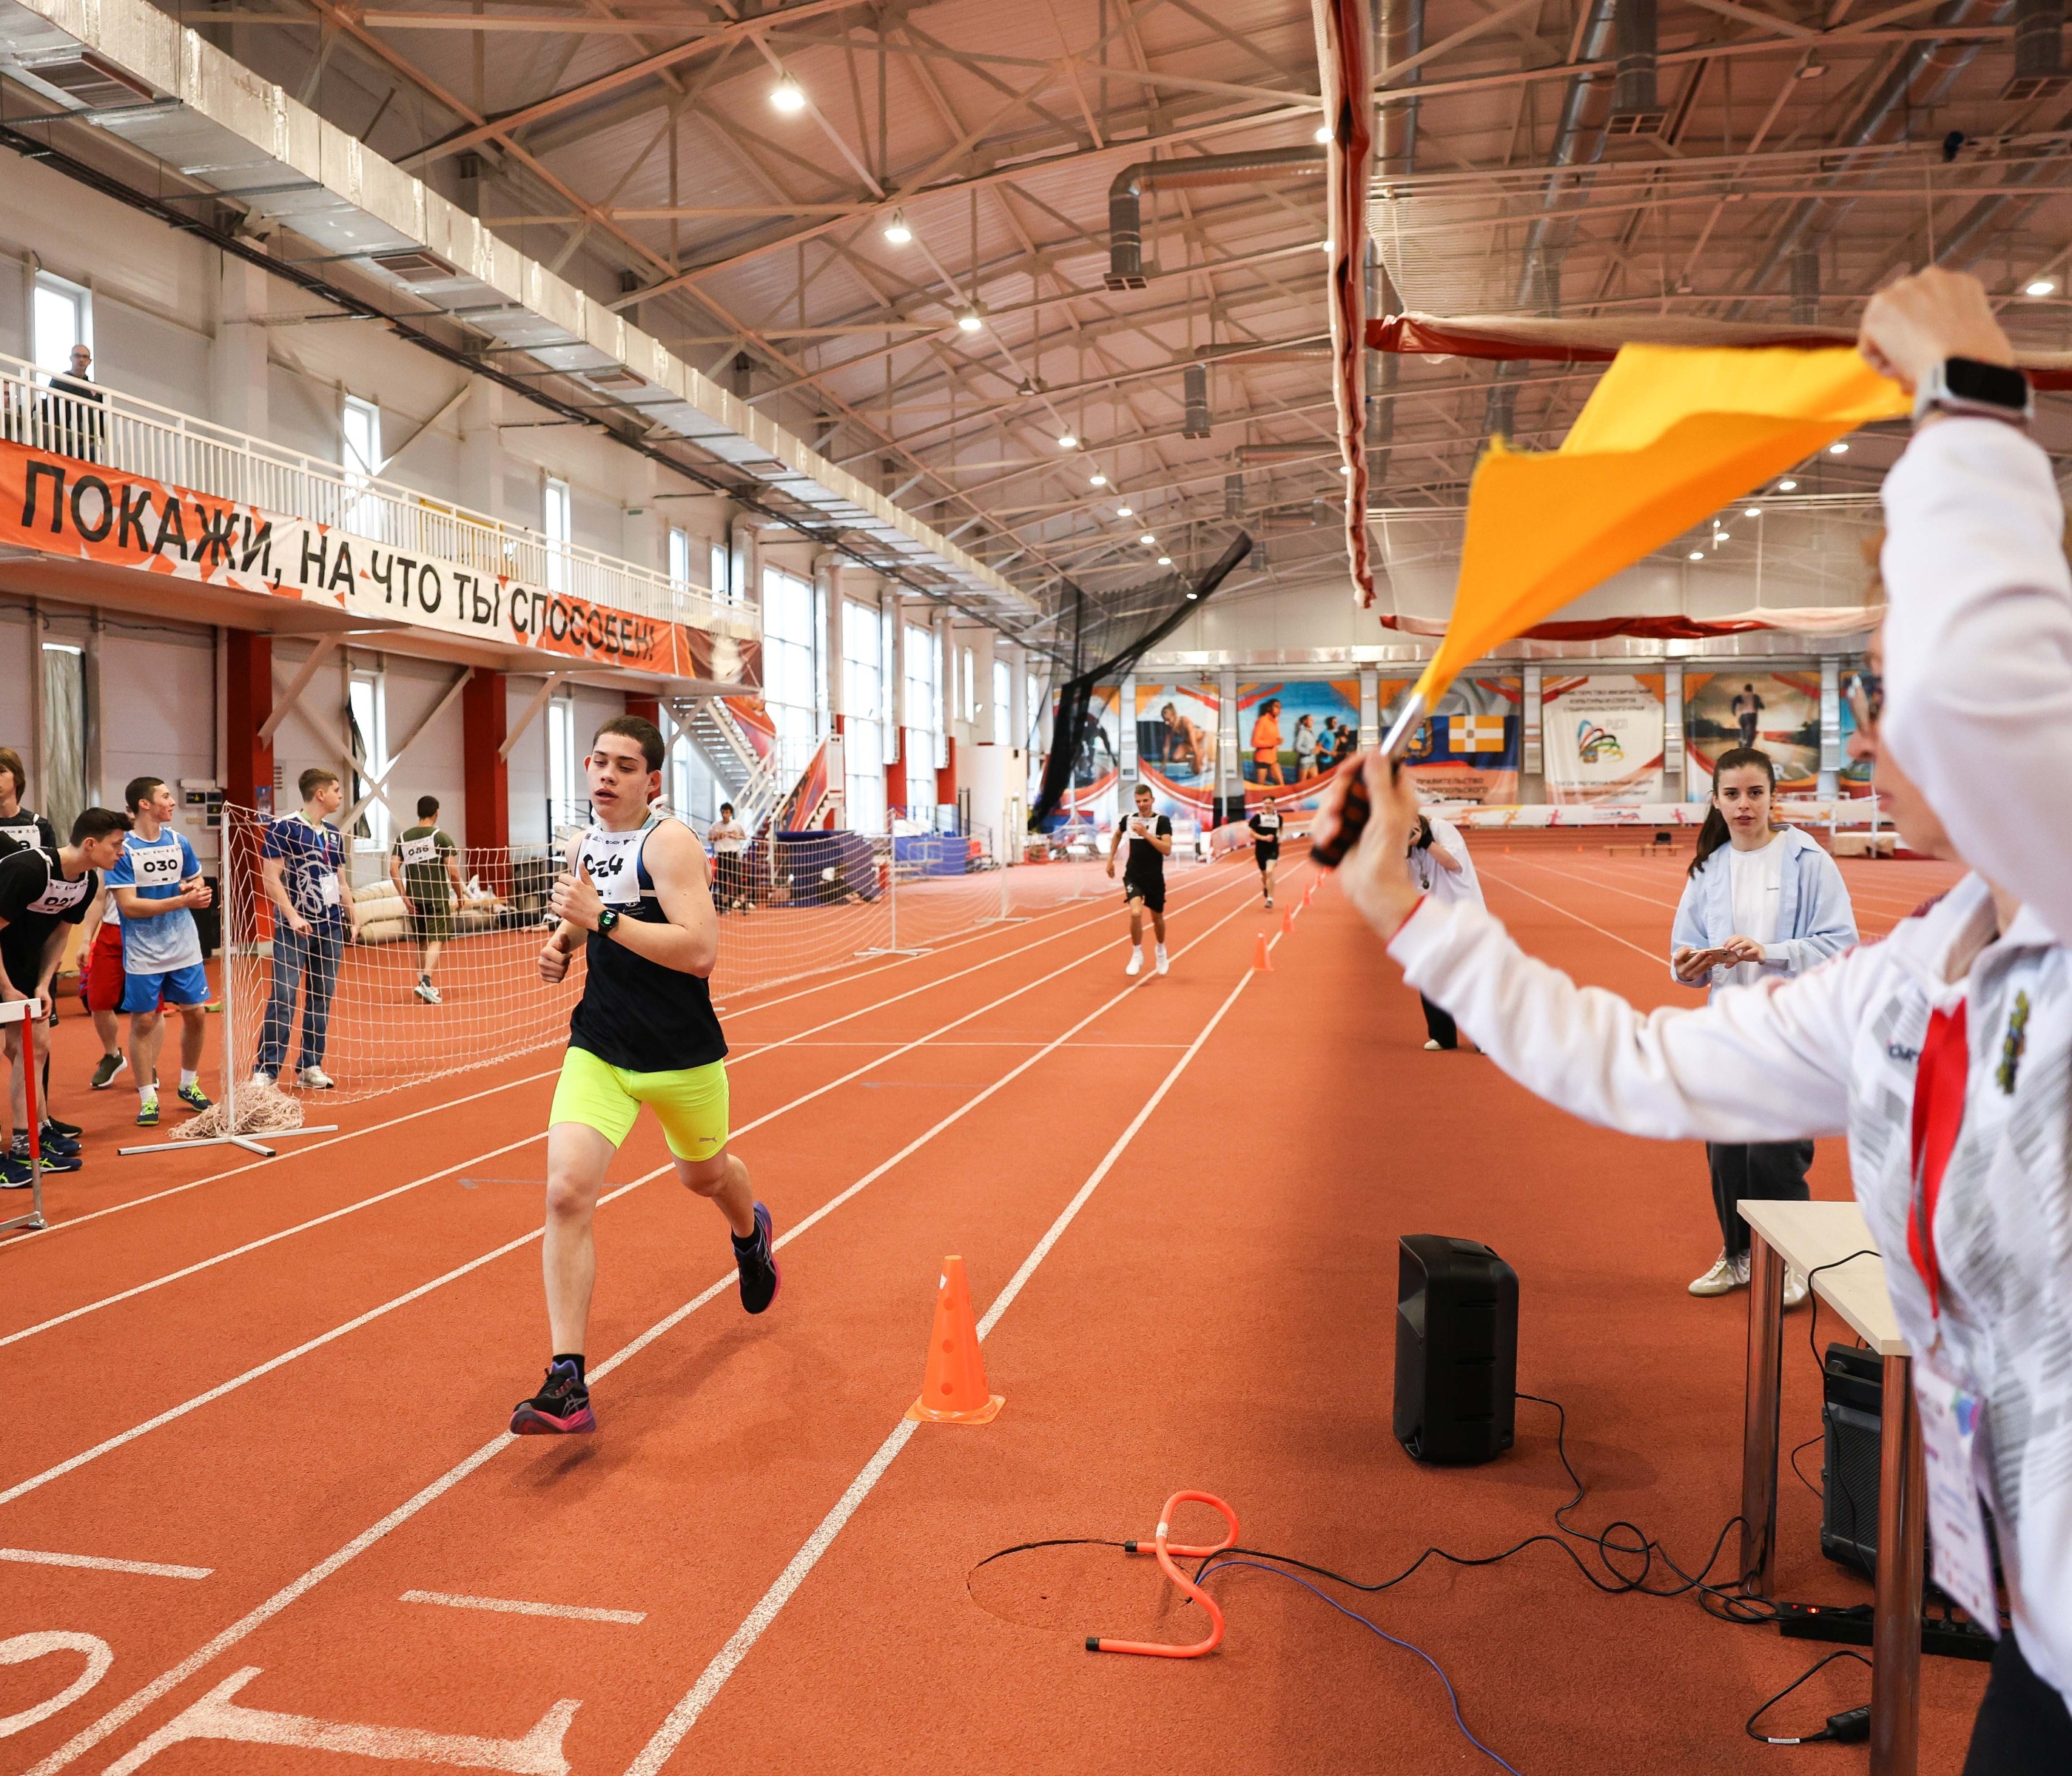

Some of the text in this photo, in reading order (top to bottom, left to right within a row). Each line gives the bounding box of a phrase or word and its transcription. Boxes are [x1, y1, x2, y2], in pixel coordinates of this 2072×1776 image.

[21, 460, 656, 662] ПОКАЖИ, НА ЧТО ТЫ СПОСОБЕН!
[144, 859, 178, 873] 030
